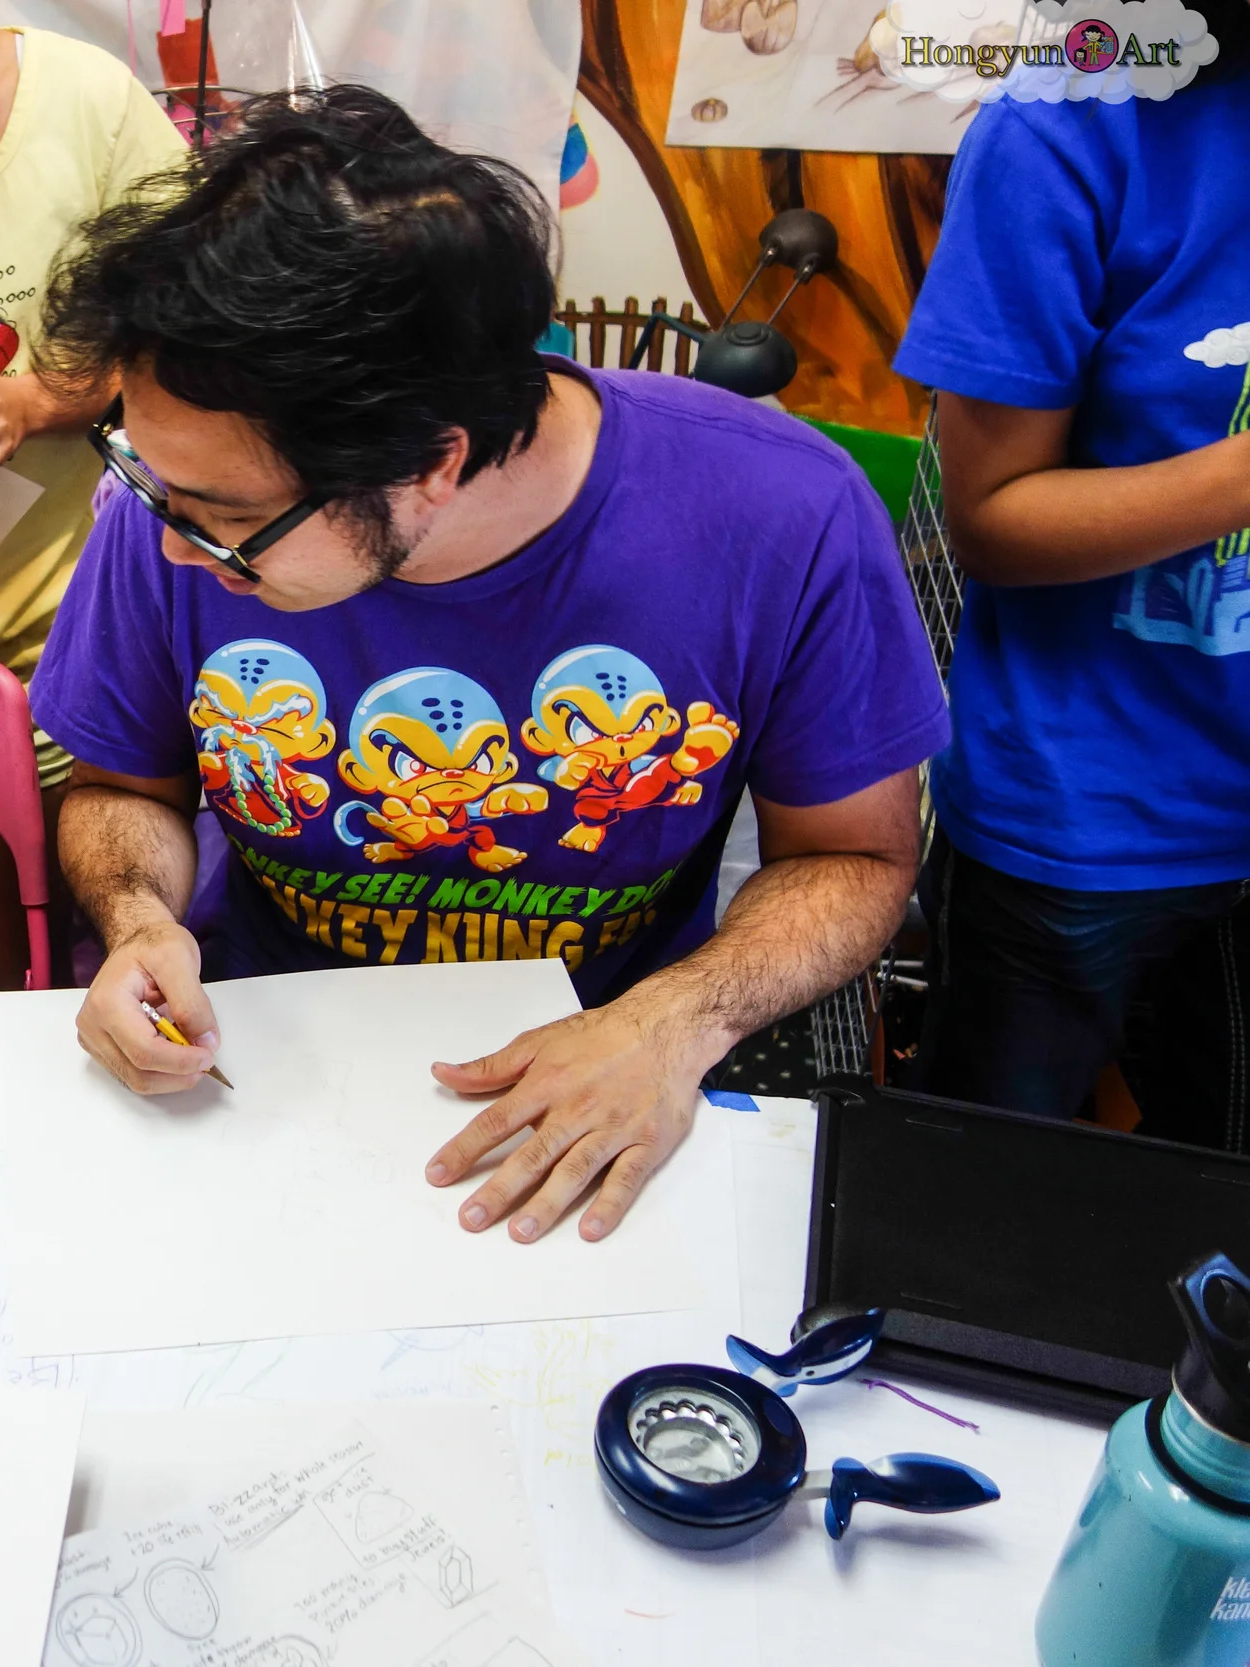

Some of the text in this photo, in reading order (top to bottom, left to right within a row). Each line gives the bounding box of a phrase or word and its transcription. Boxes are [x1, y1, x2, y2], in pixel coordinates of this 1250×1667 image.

[336, 872, 430, 905] SEE!
[427, 876, 616, 918] MONKEY
[419, 911, 584, 975] KUNG
